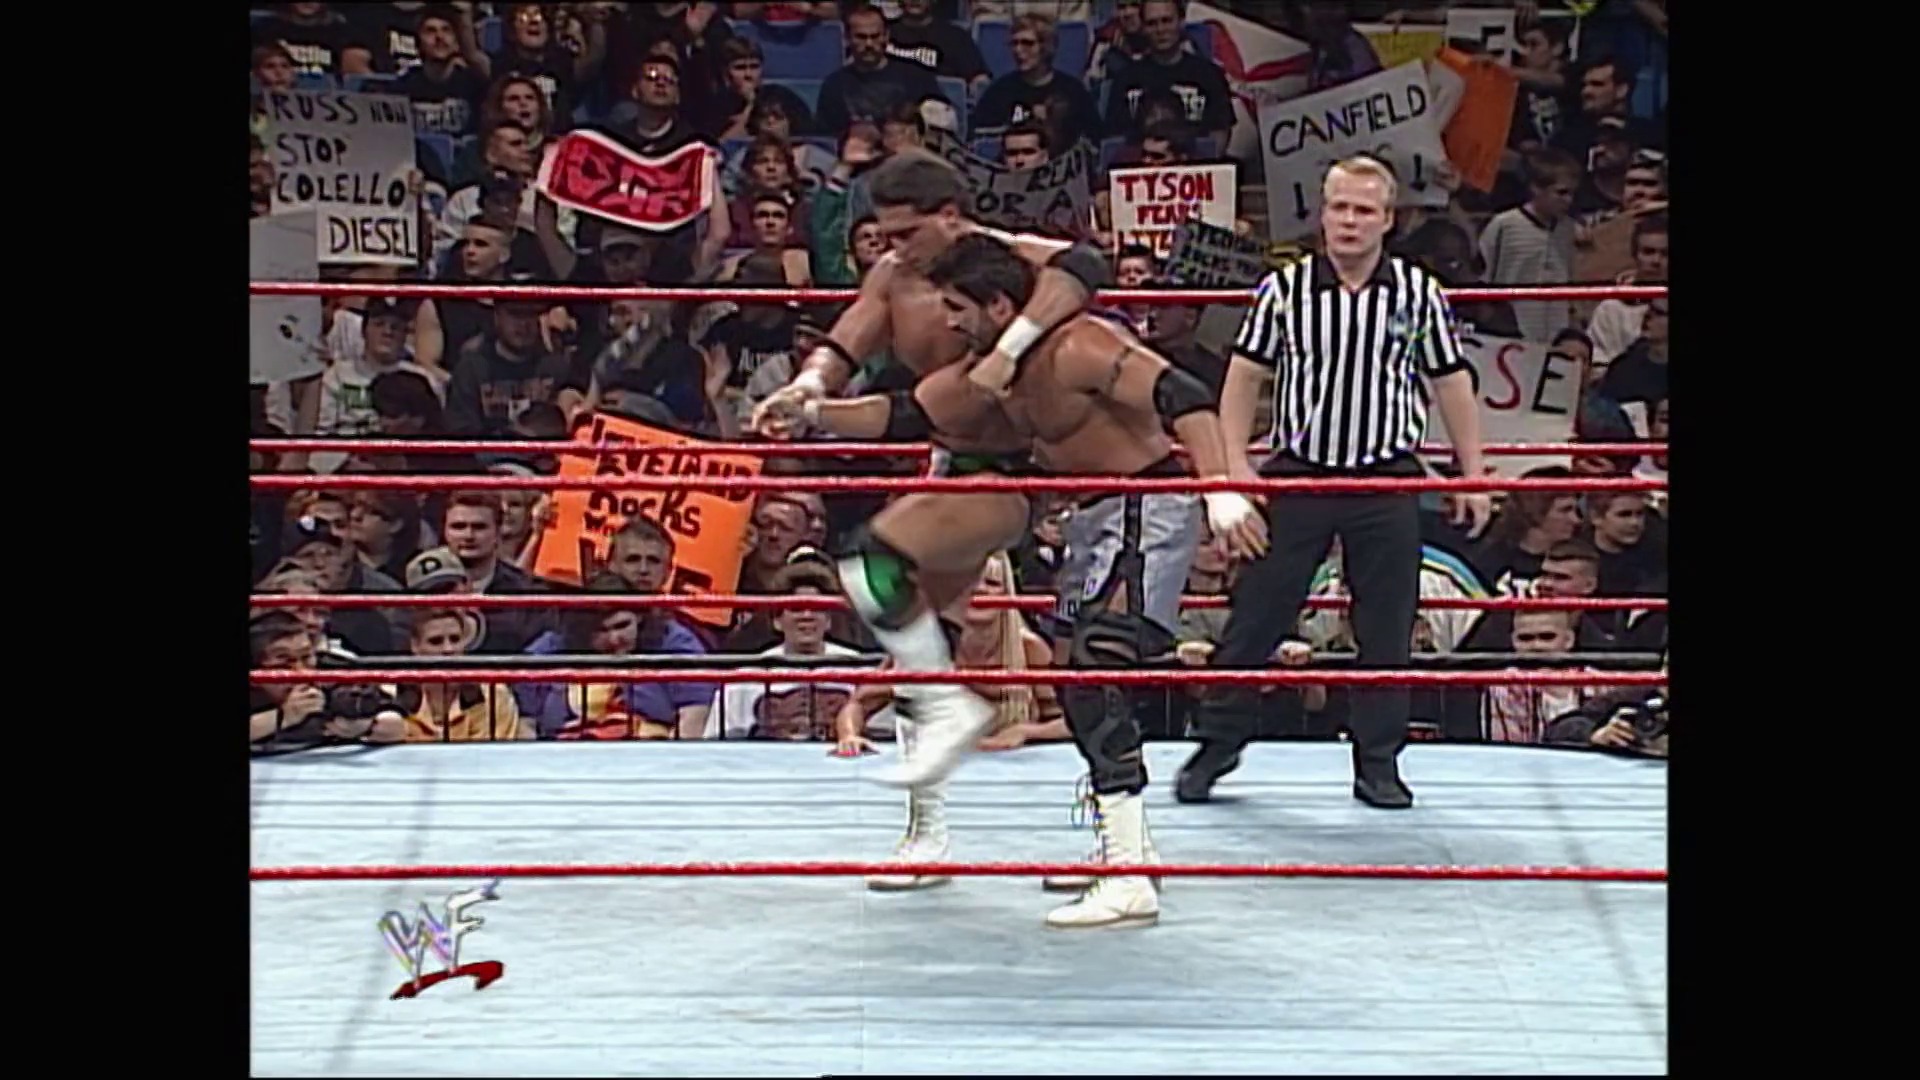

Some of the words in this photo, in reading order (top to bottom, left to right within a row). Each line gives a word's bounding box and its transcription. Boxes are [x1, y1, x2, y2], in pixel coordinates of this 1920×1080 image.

[273, 94, 358, 125] RUSS
[1270, 84, 1427, 157] CANFIELD
[277, 134, 348, 167] STOP
[277, 175, 406, 208] COLELLO
[1116, 171, 1215, 203] TYSON
[329, 216, 416, 259] DIESEL
